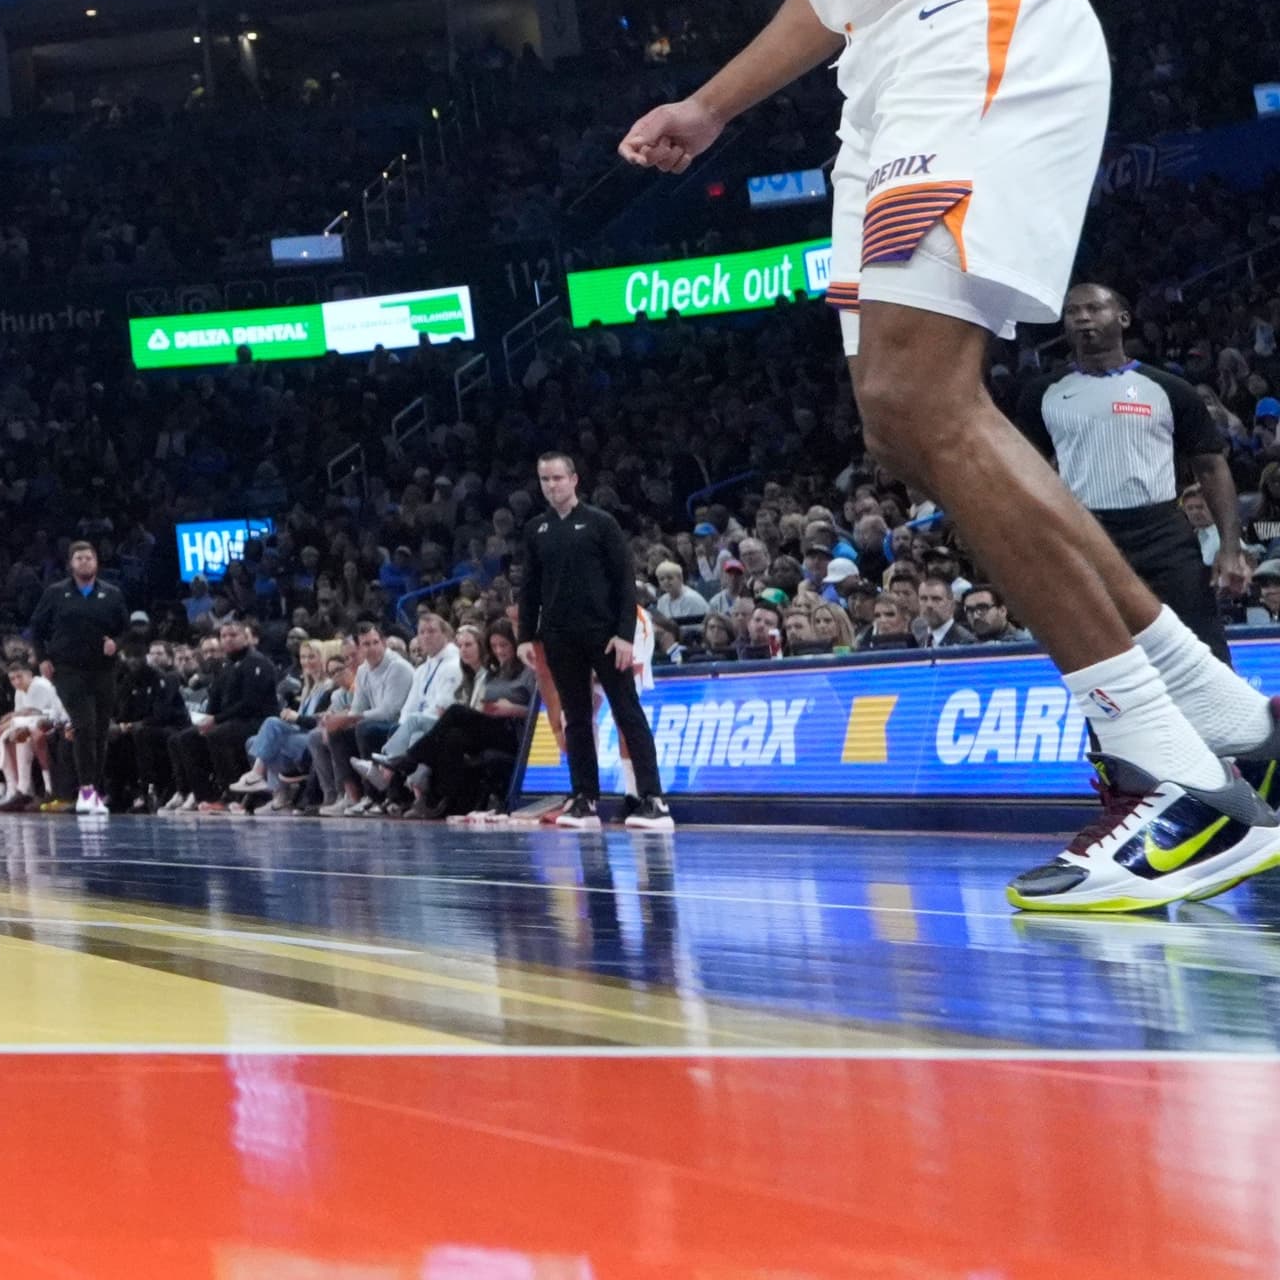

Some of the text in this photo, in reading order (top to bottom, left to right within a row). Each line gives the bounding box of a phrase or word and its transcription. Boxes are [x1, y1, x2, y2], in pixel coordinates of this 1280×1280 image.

[625, 262, 731, 315] Check
[743, 255, 793, 304] out
[174, 329, 230, 350] DELTA
[233, 323, 307, 345] DENTAL
[1114, 404, 1151, 416] Emirates
[182, 528, 268, 572] HOM
